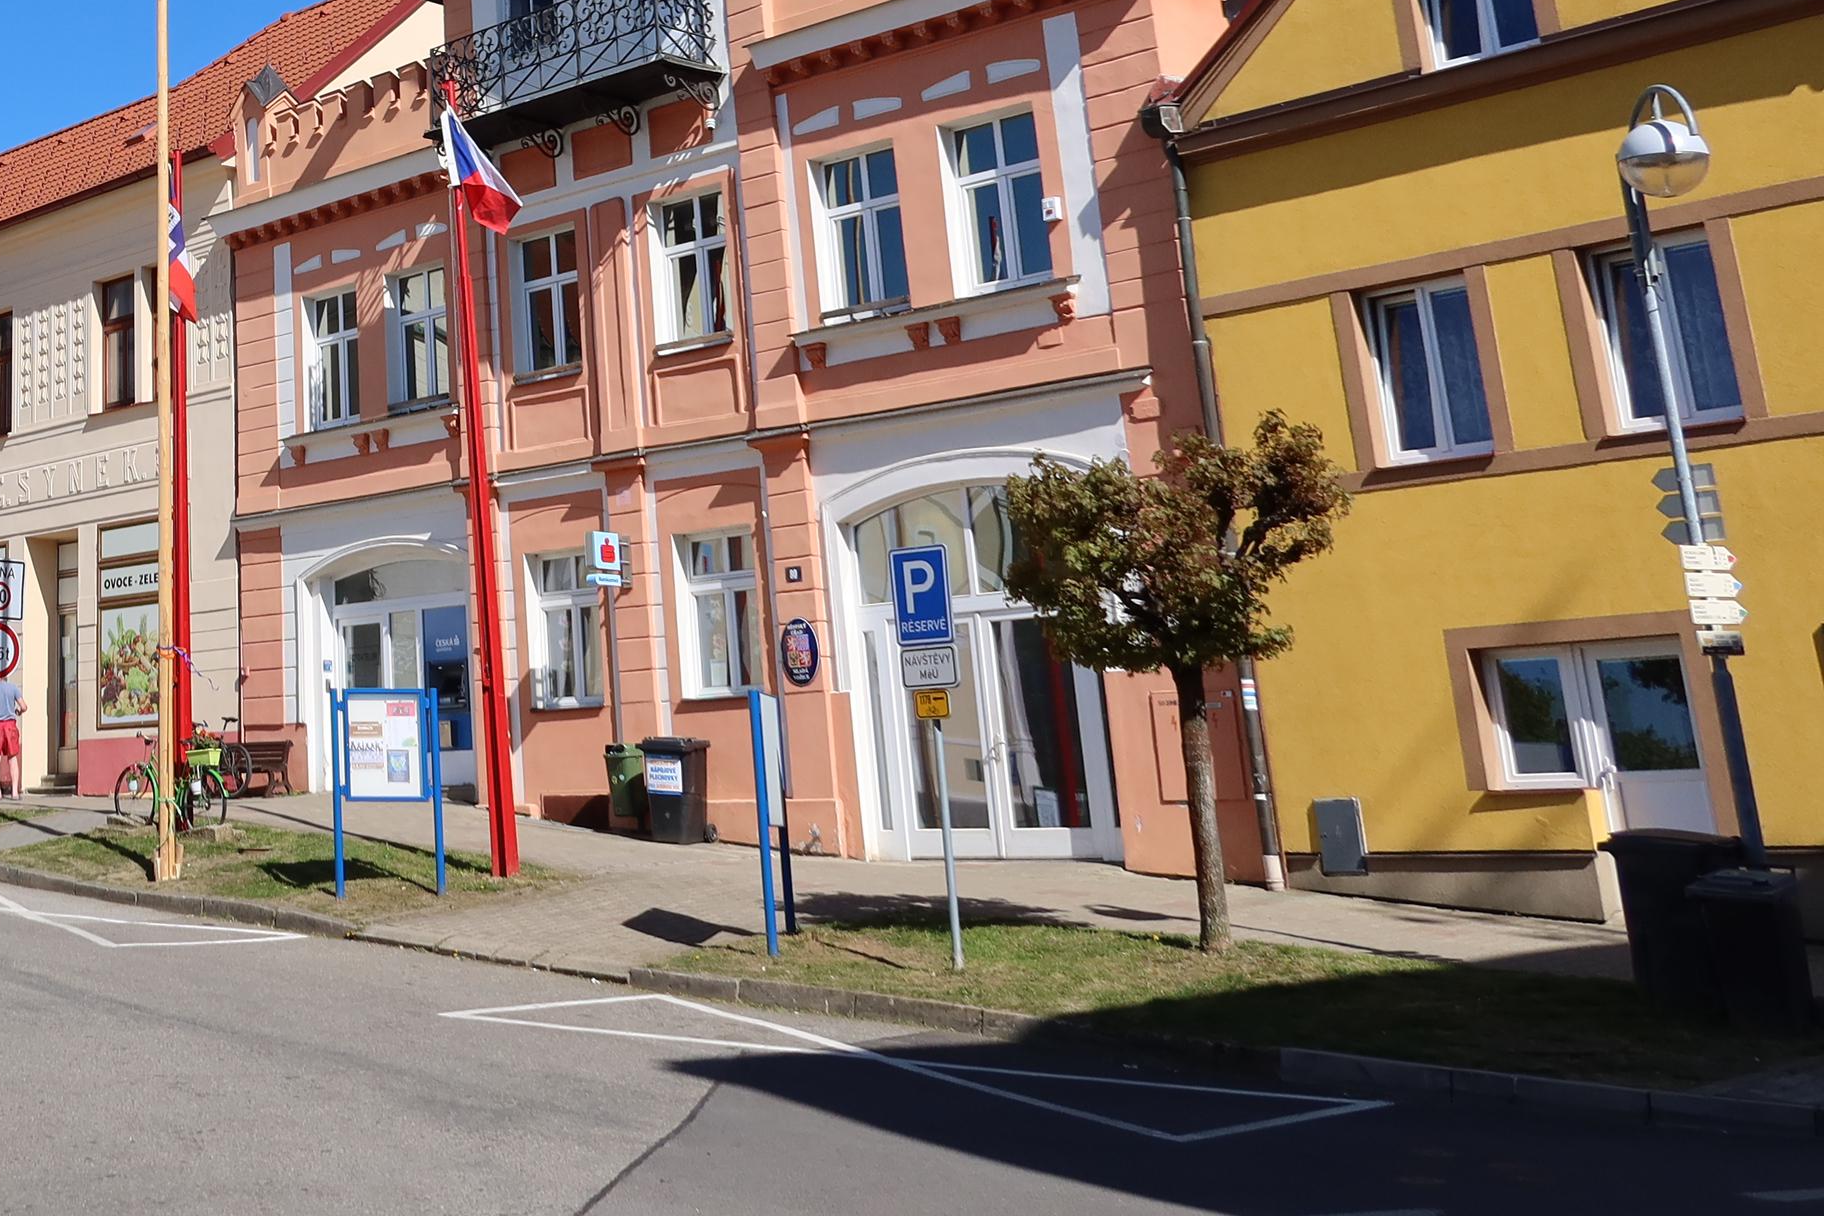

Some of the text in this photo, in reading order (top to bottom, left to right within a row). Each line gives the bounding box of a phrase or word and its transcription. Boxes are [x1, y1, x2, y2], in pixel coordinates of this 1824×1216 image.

[104, 576, 133, 590] OVOCE
[139, 573, 159, 585] ZELE
[902, 560, 935, 614] P
[901, 616, 947, 633] RÉSERVÉ
[904, 652, 951, 667] NÁVŠTĚVY
